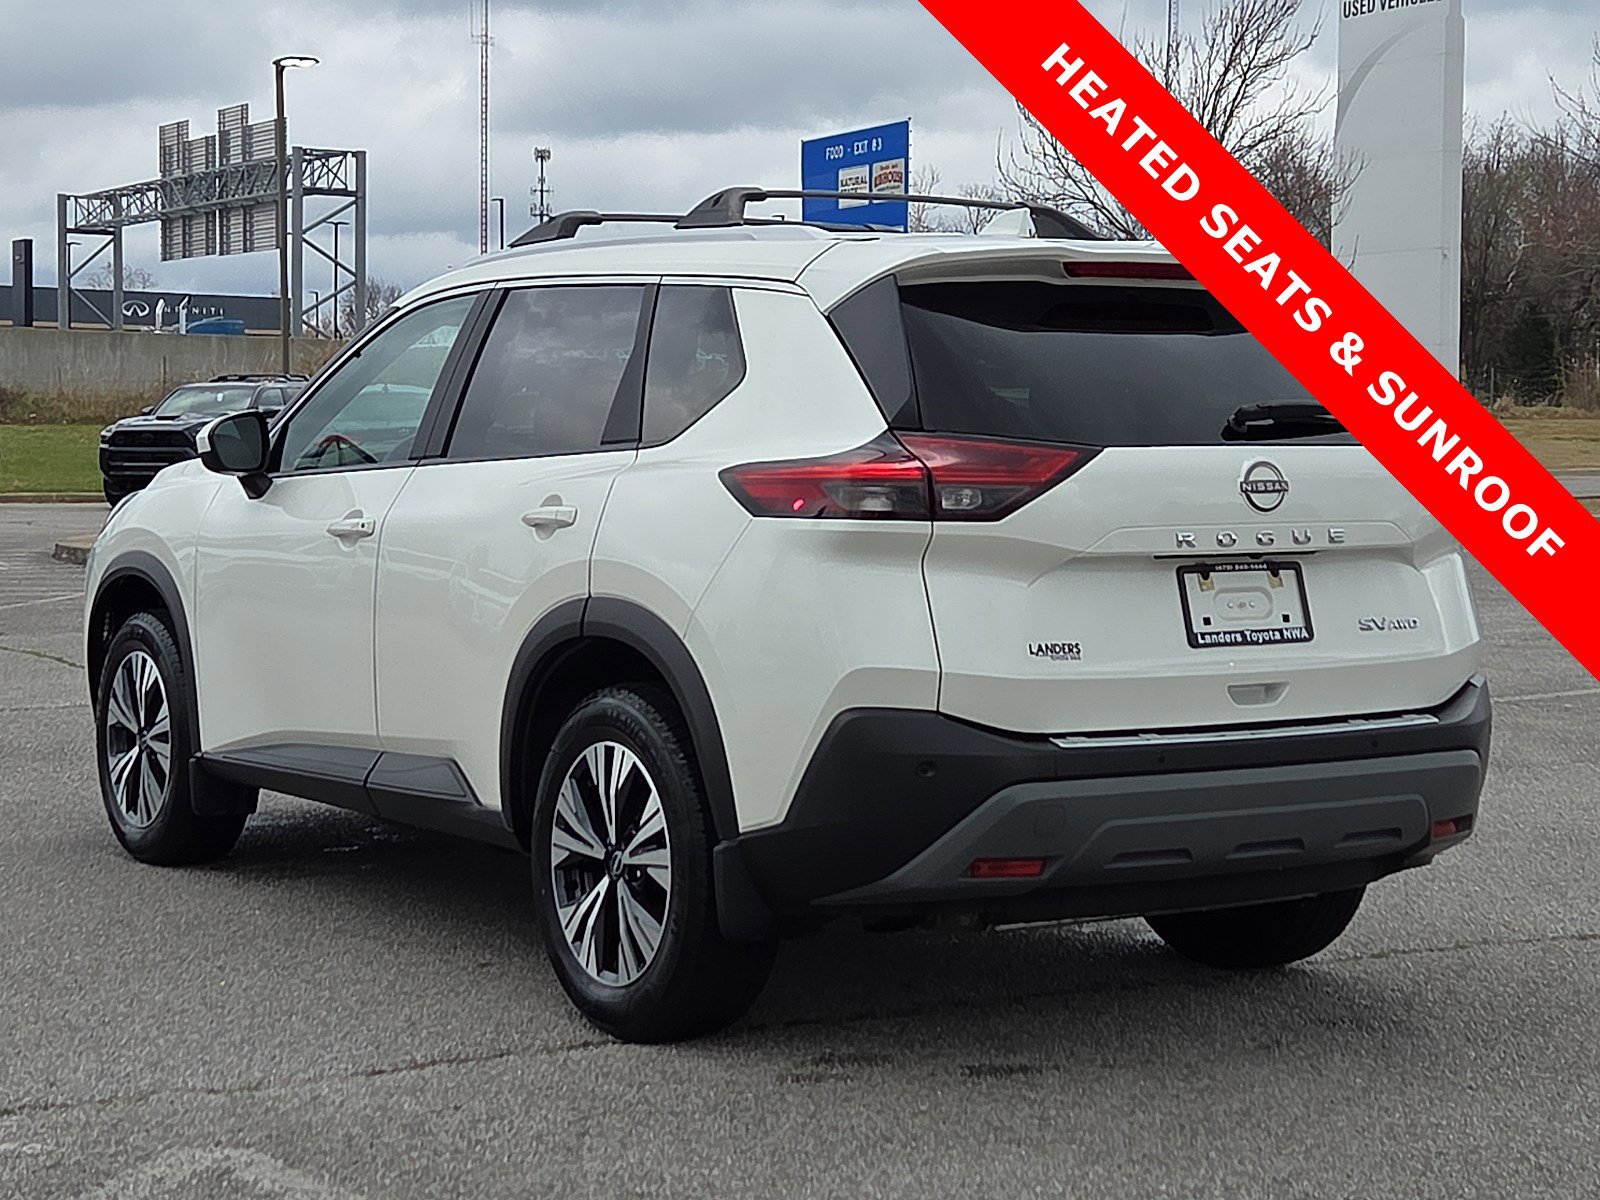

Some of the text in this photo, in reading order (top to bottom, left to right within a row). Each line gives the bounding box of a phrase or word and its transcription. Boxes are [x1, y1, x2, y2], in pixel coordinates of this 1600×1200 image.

[1343, 0, 1375, 18] USED
[825, 145, 844, 160] FOOD
[854, 140, 868, 155] EXIT
[840, 175, 868, 187] NATURAL
[1242, 482, 1288, 491] NISSAN
[1175, 528, 1346, 548] ROGUE
[1358, 617, 1418, 631] SV AWD
[1197, 627, 1309, 645] Landers Toyota NWA
[1028, 642, 1081, 656] LANDERS
